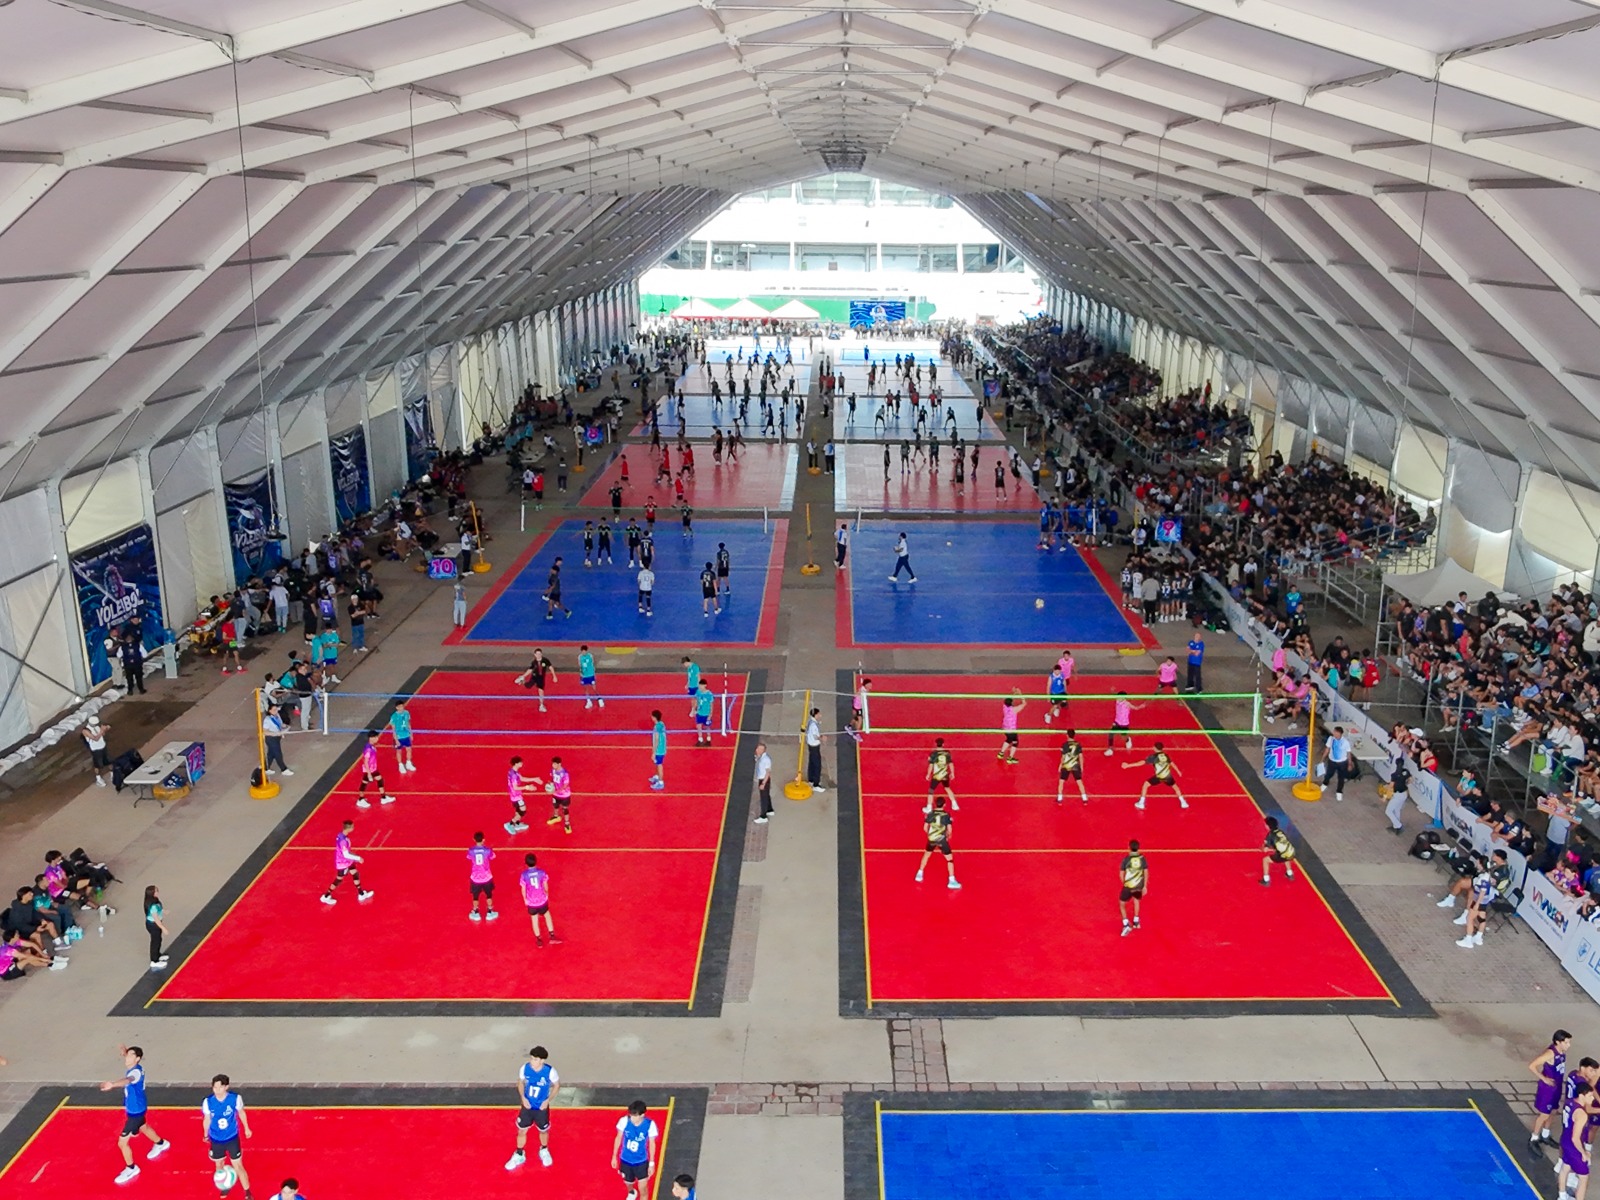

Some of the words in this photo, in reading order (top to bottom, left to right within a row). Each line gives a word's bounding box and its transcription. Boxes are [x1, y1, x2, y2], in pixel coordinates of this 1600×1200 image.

[431, 558, 454, 574] 10
[96, 589, 144, 626] VOLEIBOL
[1272, 744, 1299, 768] 11
[530, 876, 539, 889] 4
[529, 1085, 541, 1098] 17
[217, 1118, 229, 1130] 9
